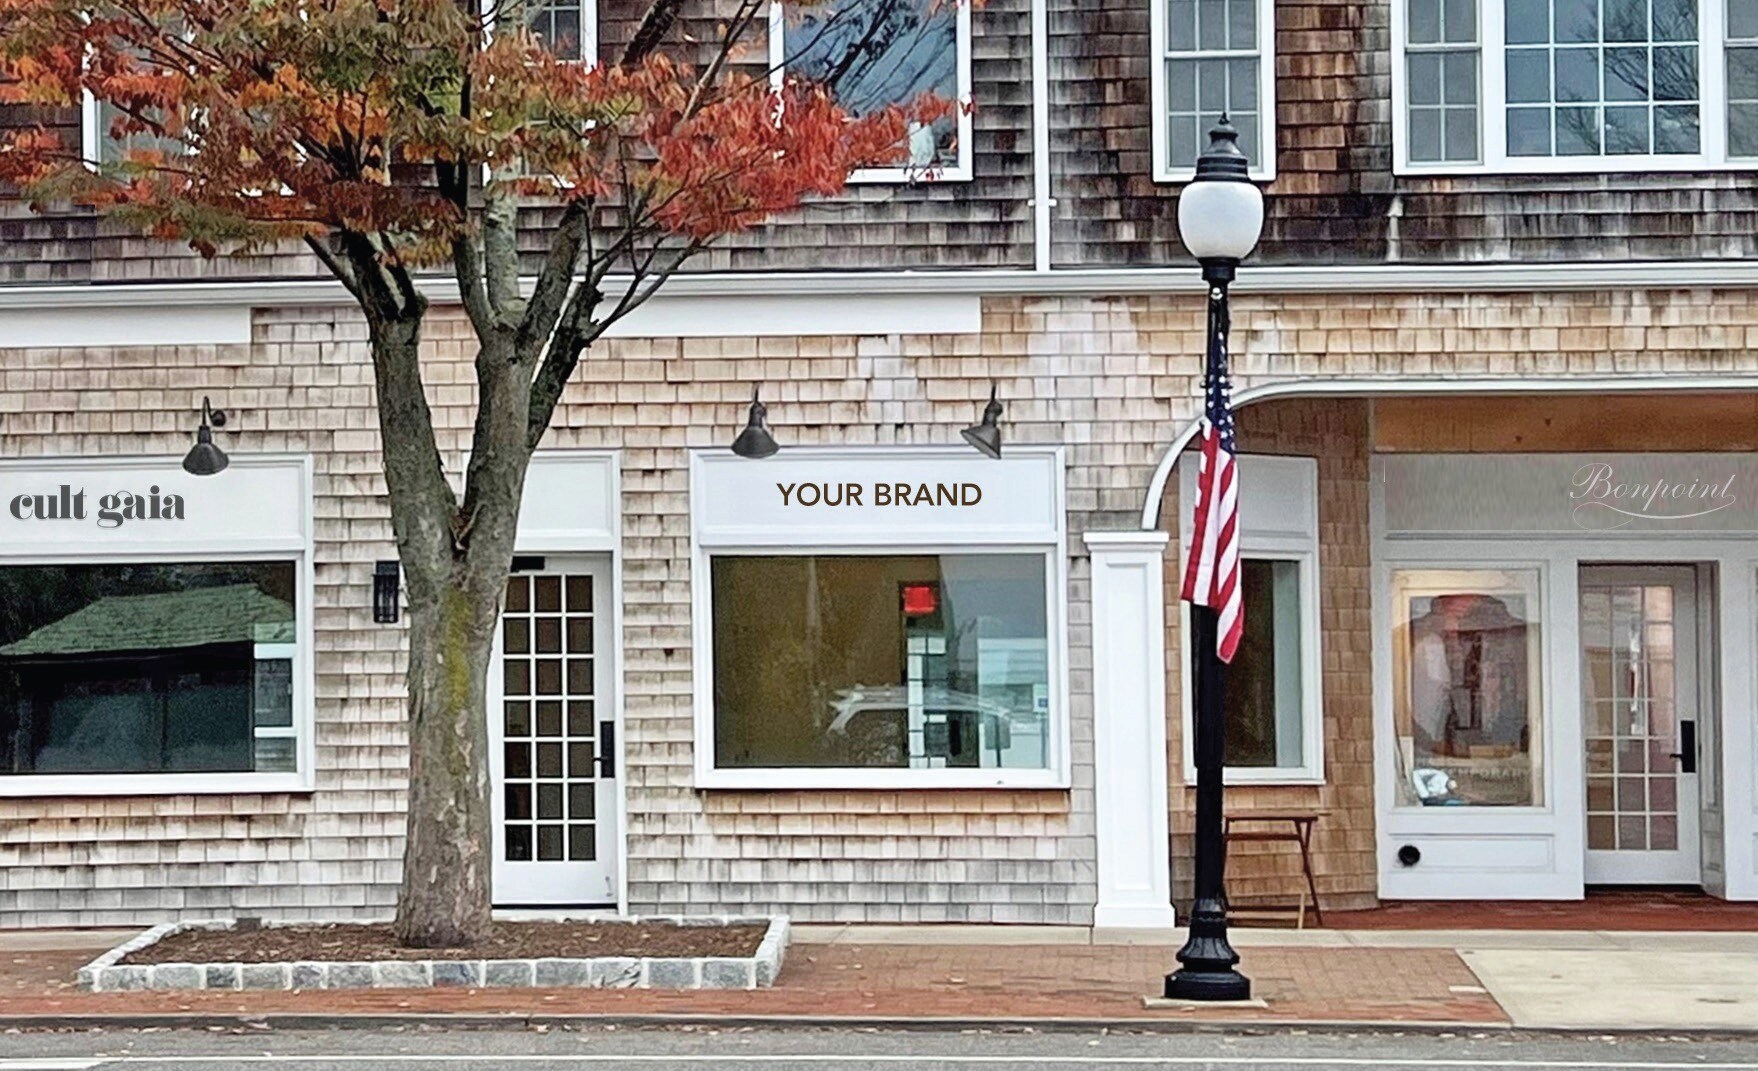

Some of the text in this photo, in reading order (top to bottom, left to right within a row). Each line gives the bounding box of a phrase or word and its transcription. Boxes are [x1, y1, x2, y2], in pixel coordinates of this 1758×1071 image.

[9, 484, 186, 529] cult gaia
[776, 482, 983, 507] YOUR BRAND
[1569, 462, 1736, 520] Bonpoint
